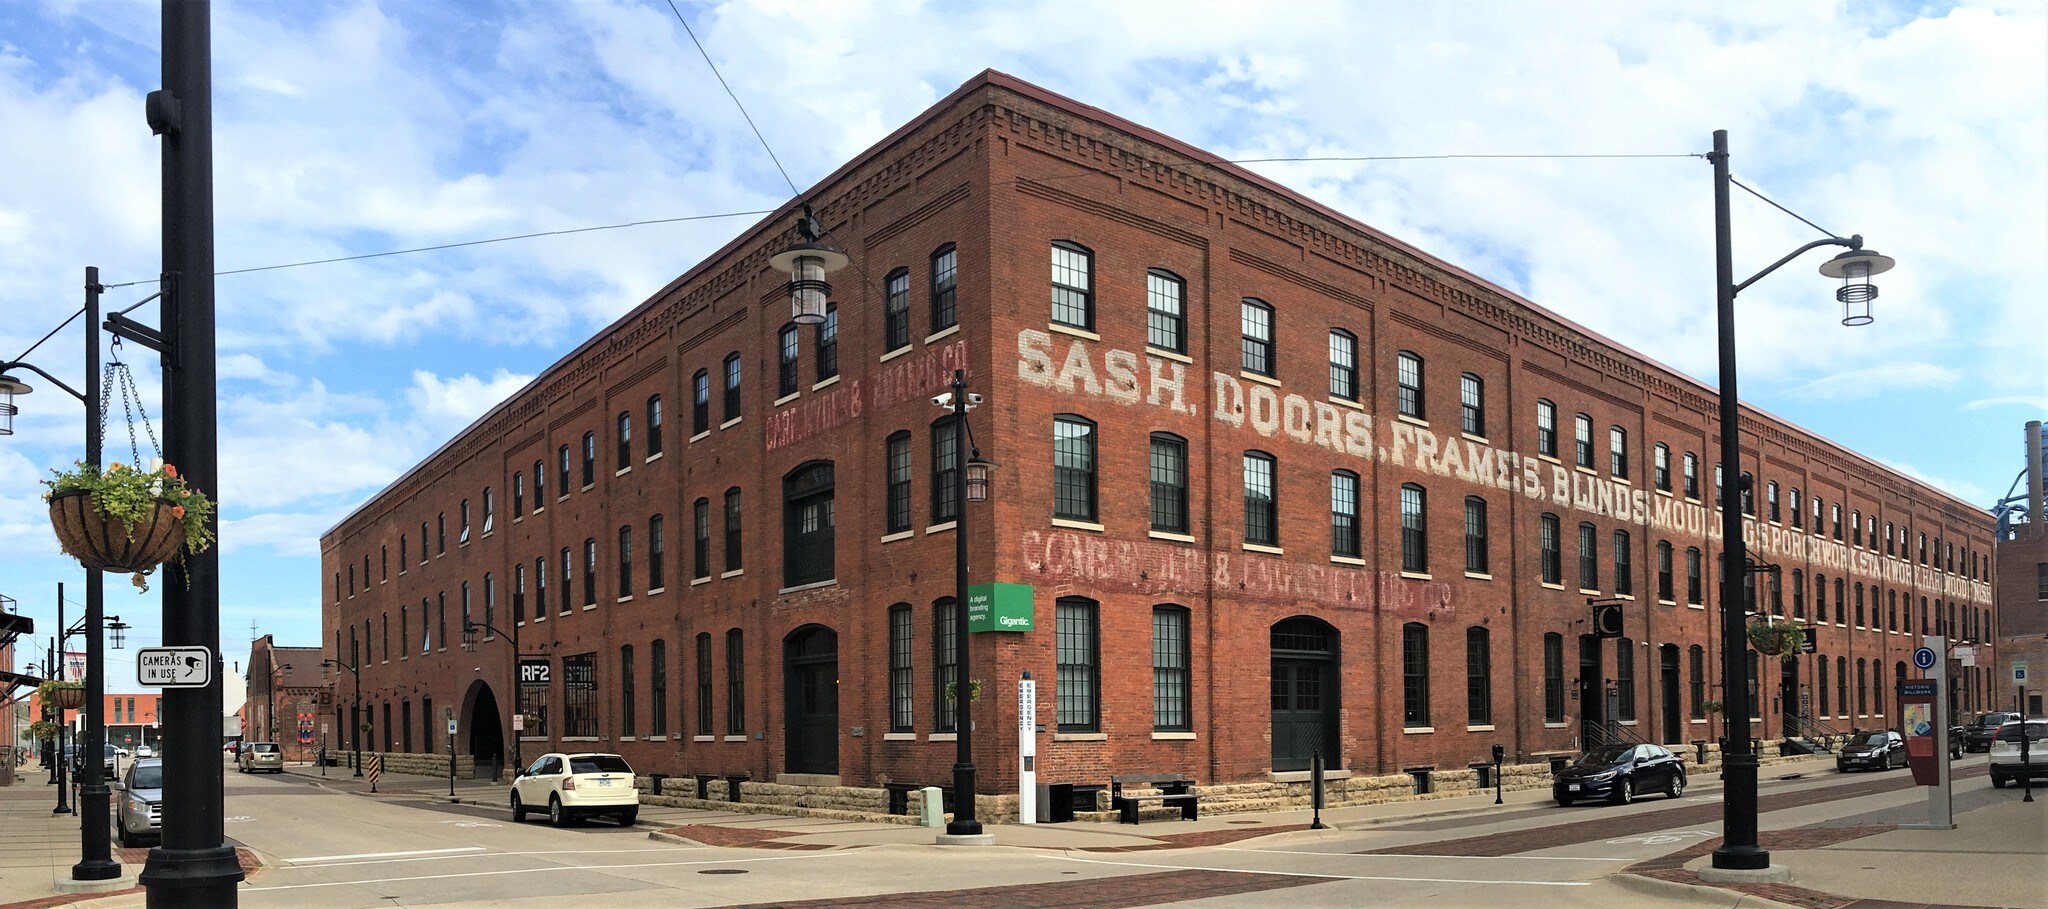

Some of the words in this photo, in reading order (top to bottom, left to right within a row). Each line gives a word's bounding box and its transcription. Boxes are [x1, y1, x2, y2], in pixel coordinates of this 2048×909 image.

[1017, 328, 1197, 417] SASH,
[974, 594, 987, 603] digital
[969, 604, 988, 612] branding
[999, 615, 1030, 628] Gigantic.
[143, 656, 182, 666] CAMERAS
[148, 669, 156, 679] IN
[161, 668, 176, 679] USE
[521, 665, 550, 682] RF2
